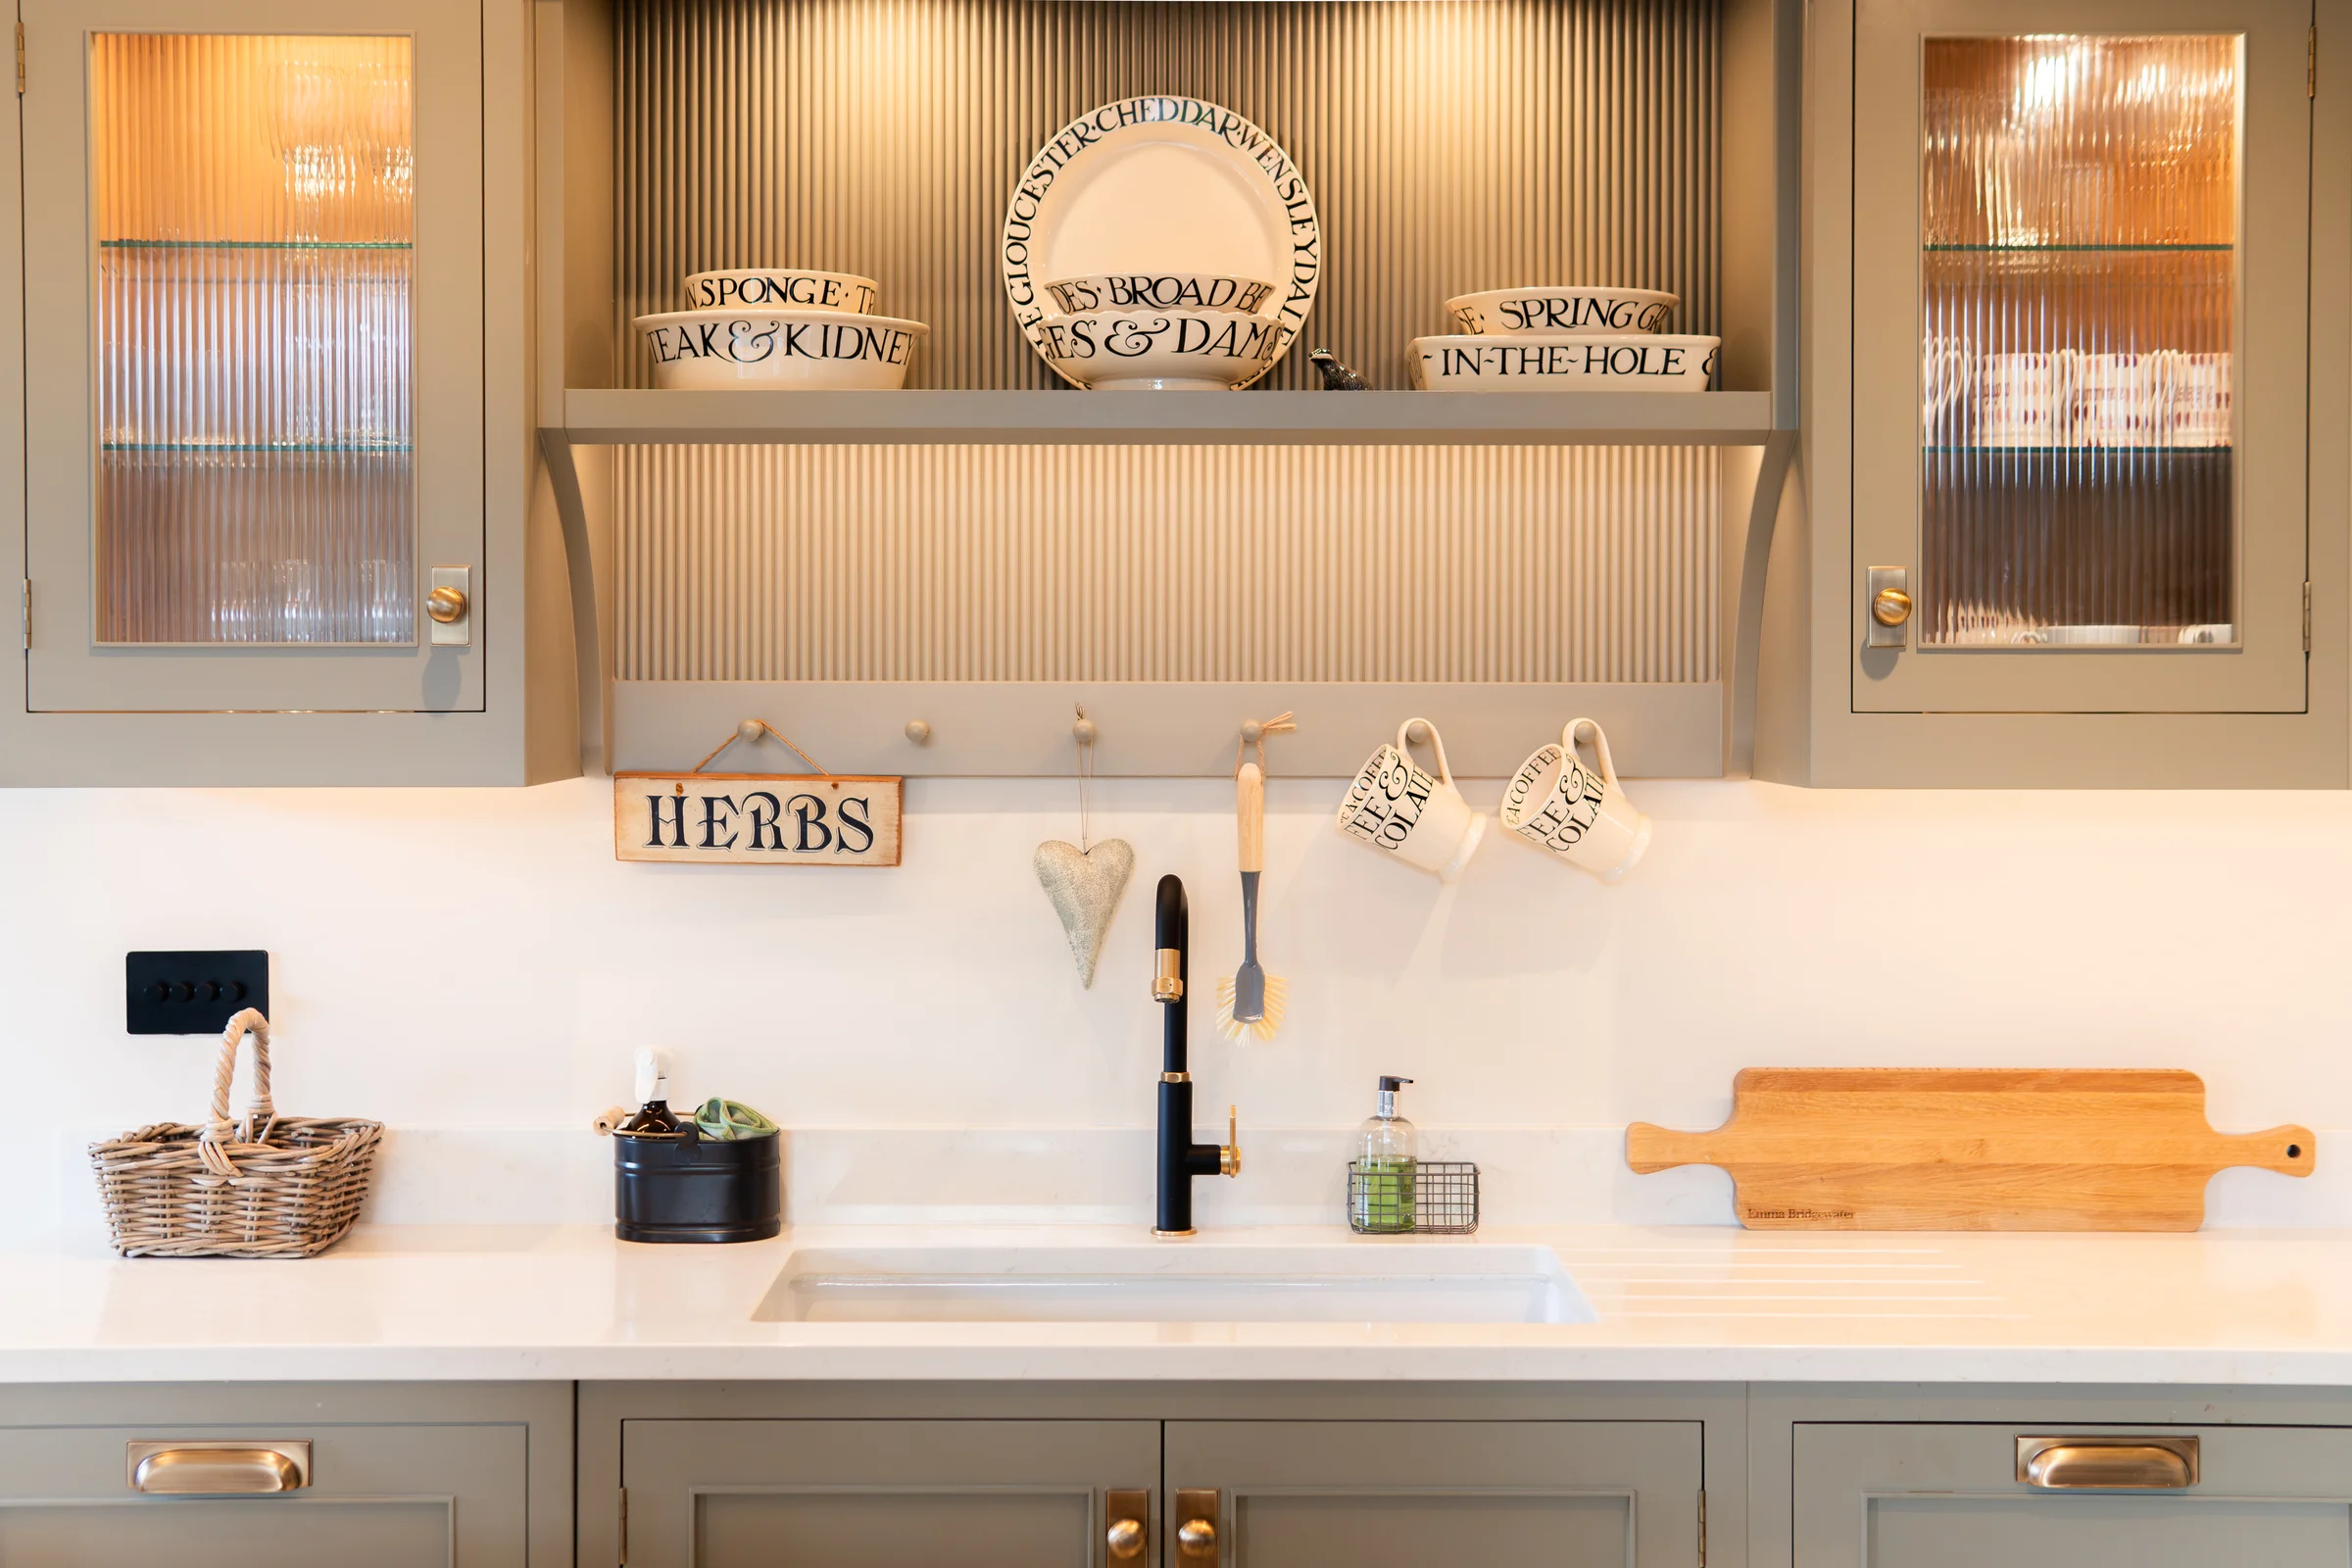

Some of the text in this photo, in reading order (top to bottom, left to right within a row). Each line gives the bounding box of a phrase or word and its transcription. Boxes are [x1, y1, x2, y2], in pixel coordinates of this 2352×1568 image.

[1104, 276, 1235, 309] BROAD
[1499, 297, 1639, 329] SPRING
[728, 319, 780, 364] &
[784, 323, 917, 366] KIDNEY
[1104, 318, 1170, 357] &
[1171, 318, 1283, 362] DAMS
[1379, 751, 1408, 801] &
[642, 791, 875, 855] HERBS
[1747, 1208, 1854, 1221] Emma Bridgewater
